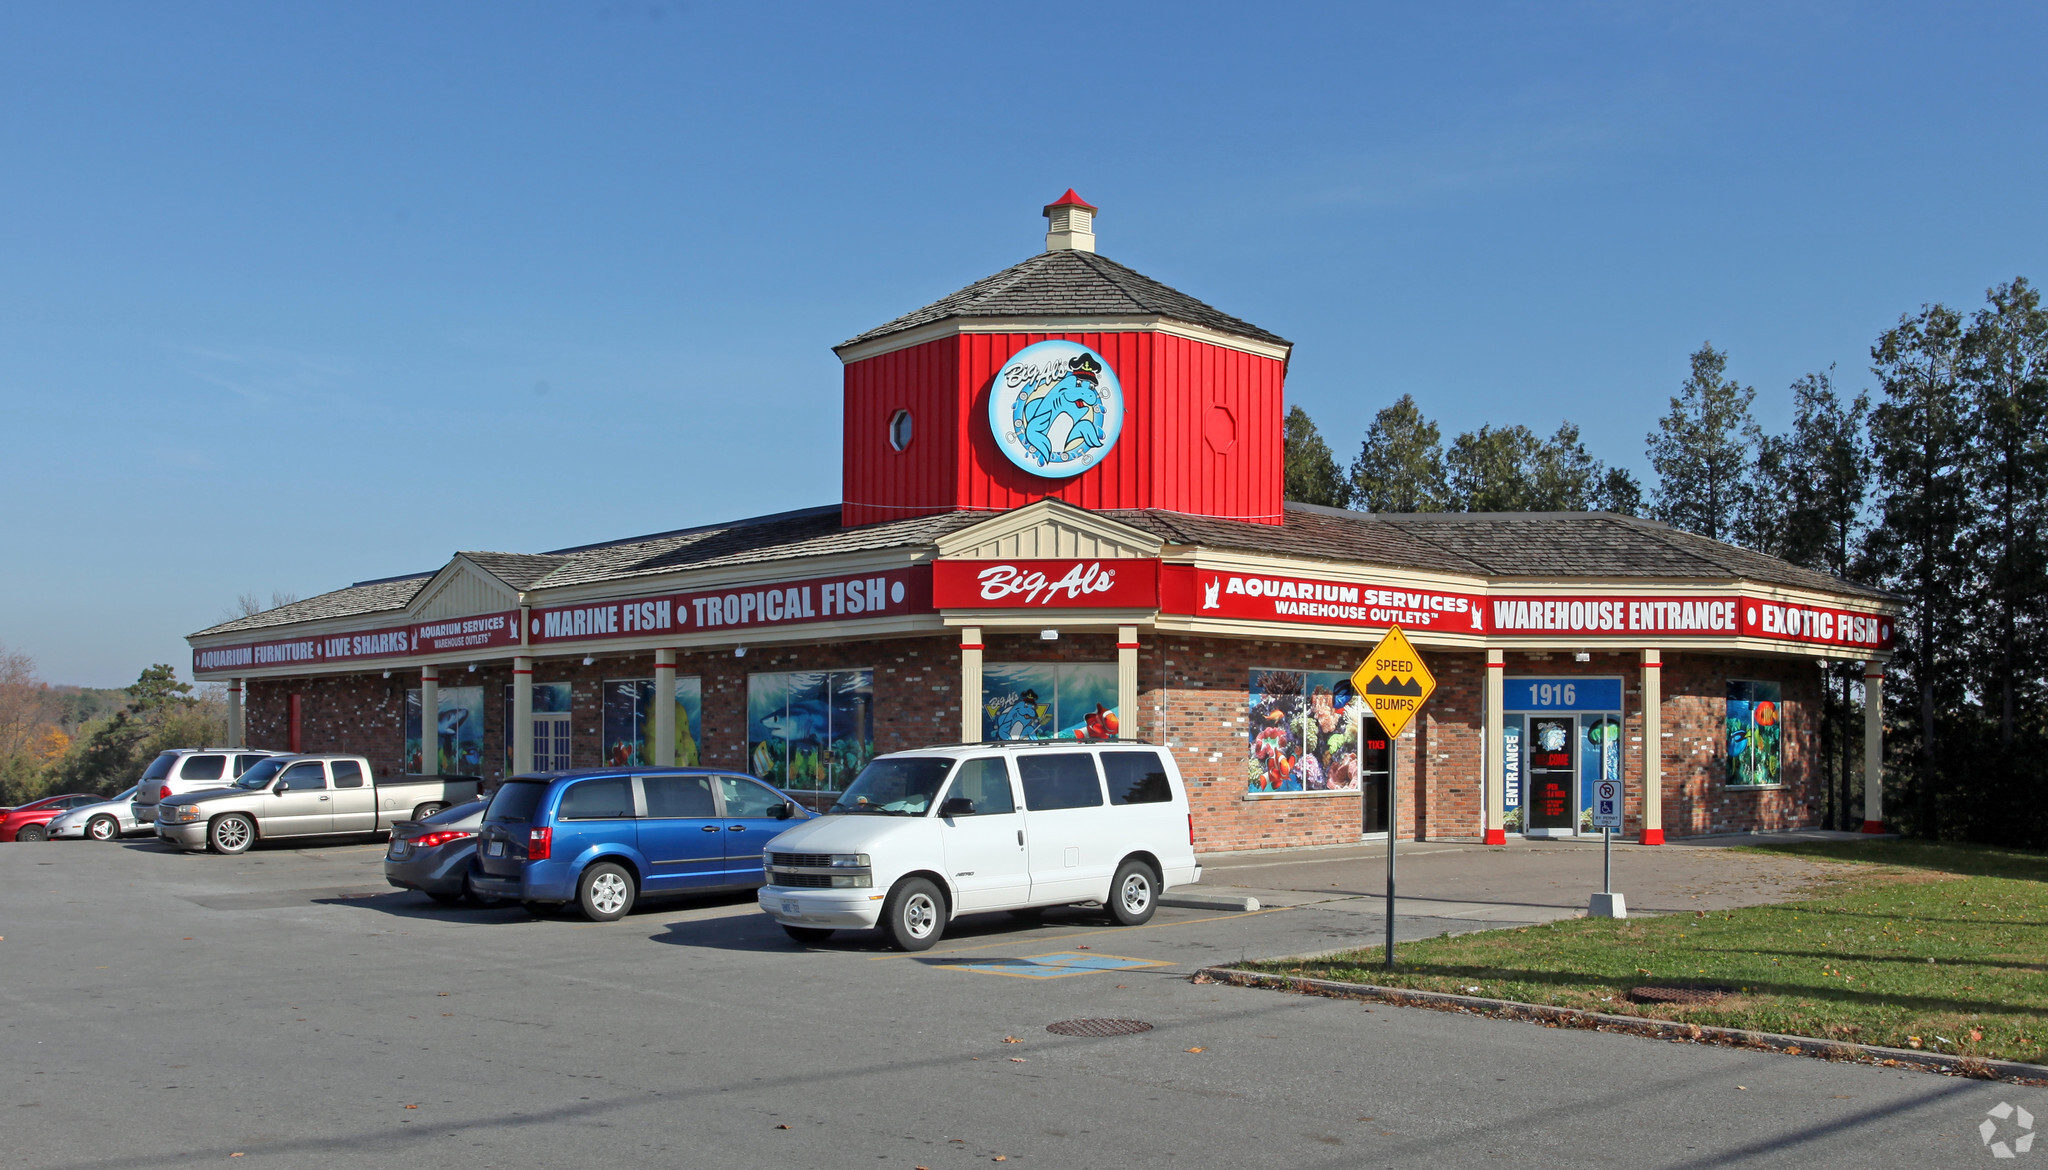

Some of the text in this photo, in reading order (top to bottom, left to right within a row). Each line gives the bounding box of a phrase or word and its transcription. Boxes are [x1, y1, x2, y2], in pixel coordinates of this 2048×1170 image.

[1004, 363, 1039, 388] Big
[977, 565, 1049, 603] Big
[1226, 577, 1468, 613] AQUARIUM SERVICES
[693, 578, 886, 627] TROPICAL FISH
[1275, 601, 1366, 620] WAREHOUSE
[1494, 601, 1735, 630] WAREHOUSE ENTRANCE
[420, 616, 504, 638] AQUARIUM SERVICES
[544, 600, 671, 638] MARINE FISH
[1762, 605, 1878, 644] EXOTIC FISH
[201, 641, 314, 669] AQUARIUM FURNITURE
[325, 631, 407, 658] LIVE SHARKS
[434, 636, 464, 648] WAREHOUSE
[1376, 659, 1413, 672] SPEED
[989, 696, 1005, 709] Big
[1376, 698, 1414, 711] BUMPS
[1529, 684, 1576, 705] 1916
[1506, 735, 1519, 806] ENTRANCE
